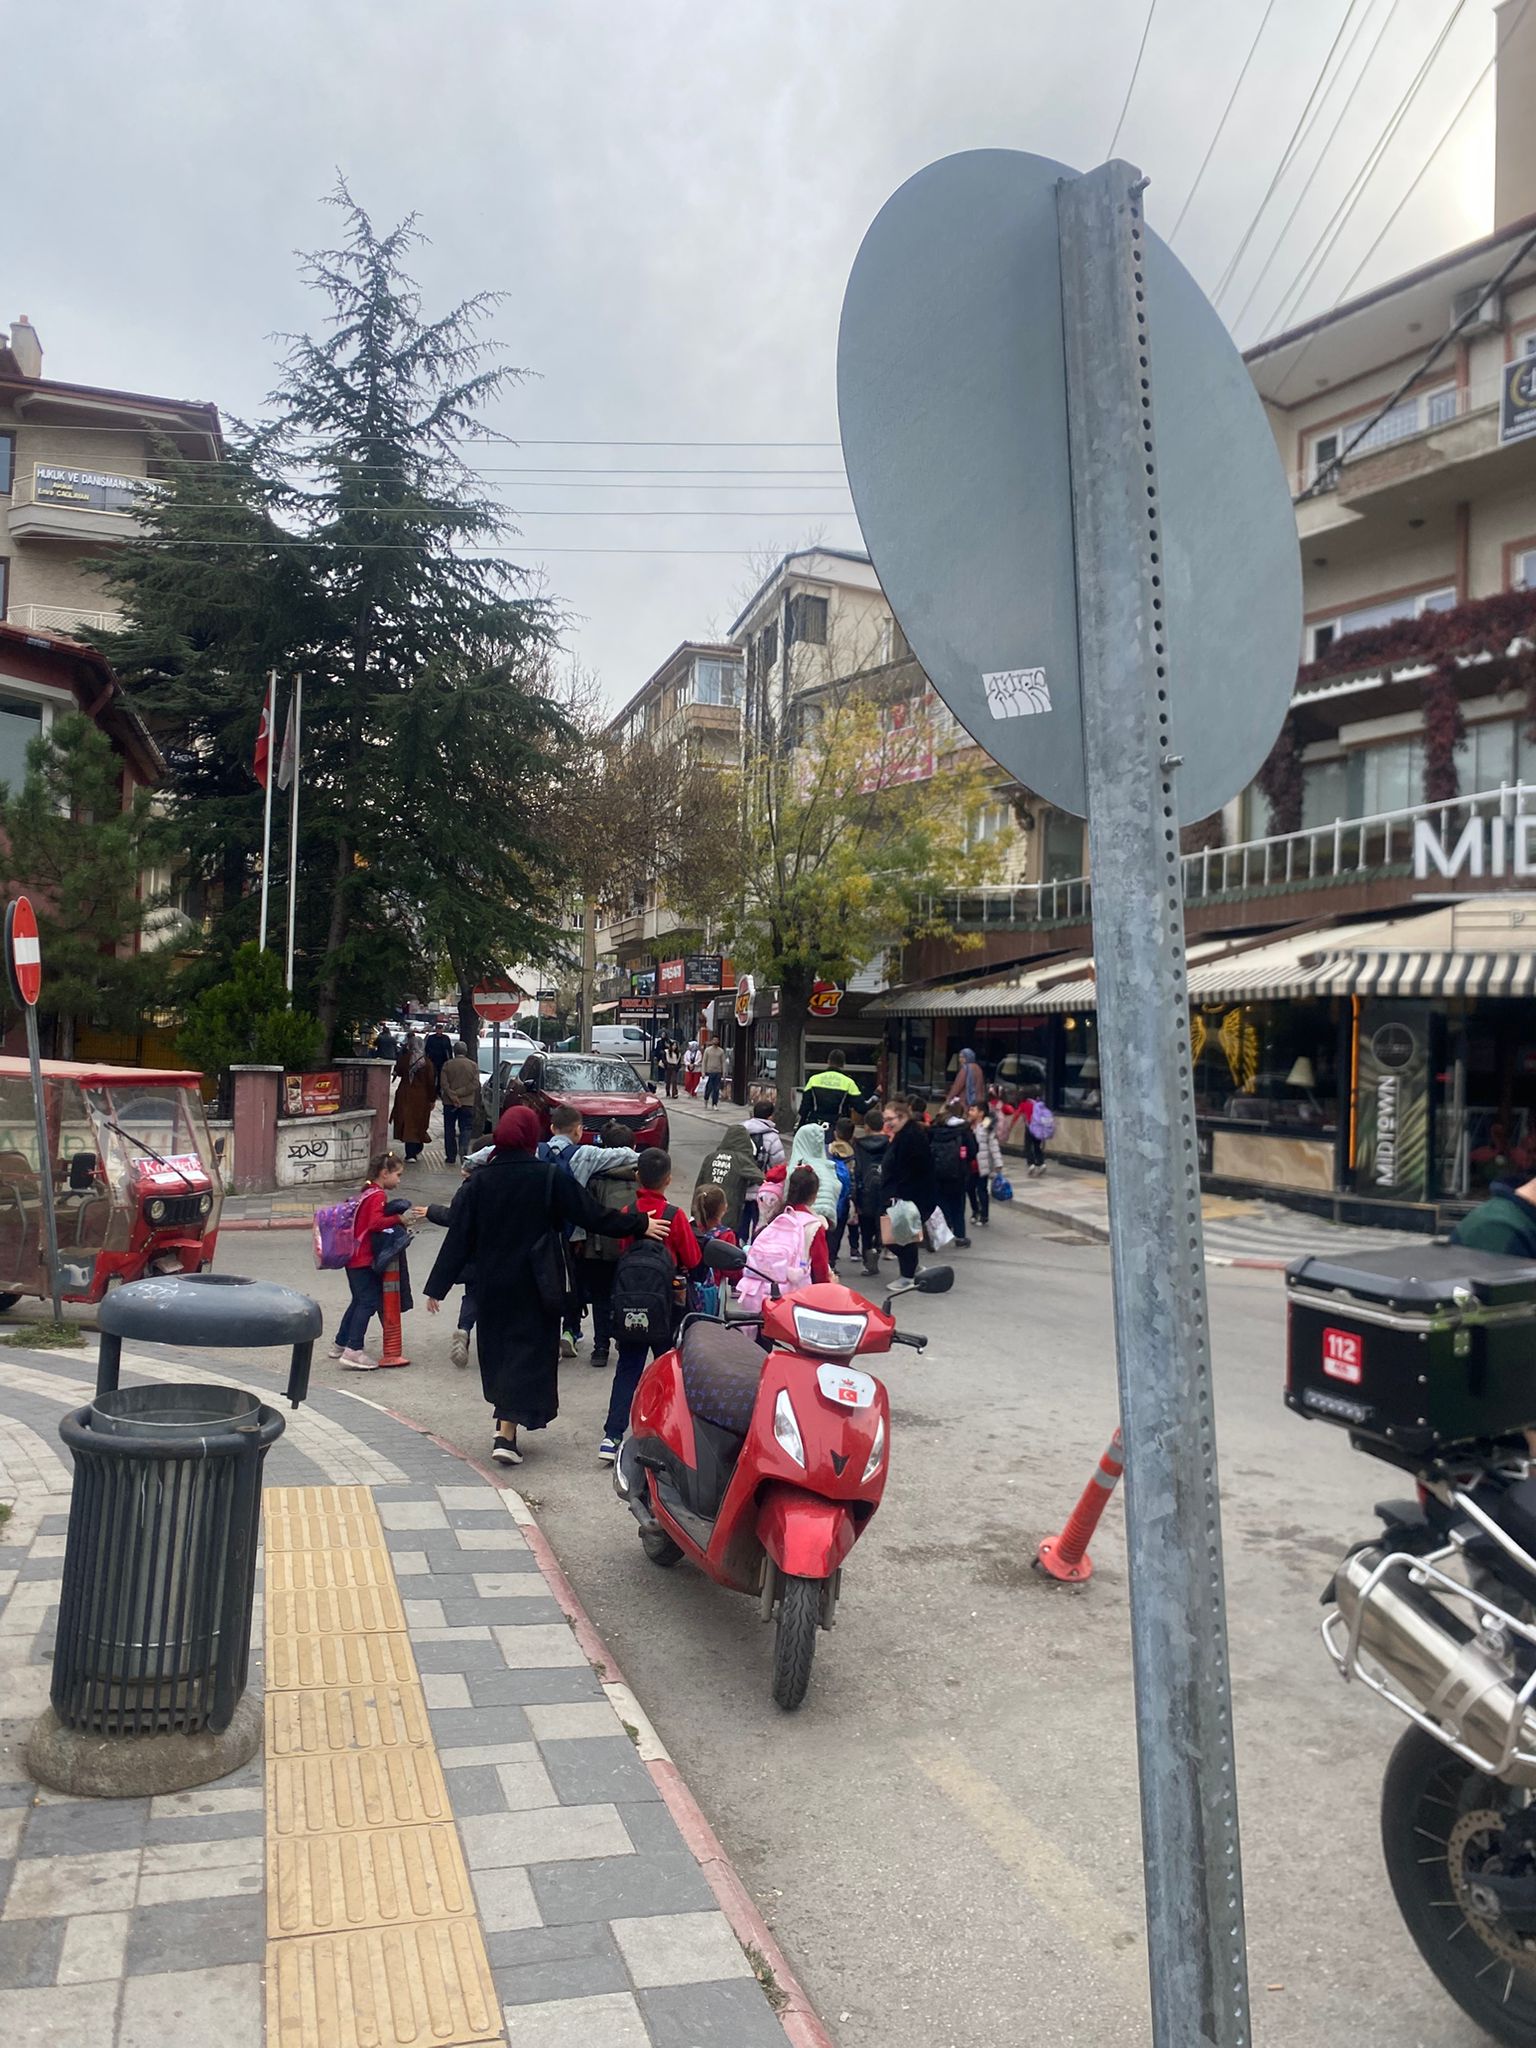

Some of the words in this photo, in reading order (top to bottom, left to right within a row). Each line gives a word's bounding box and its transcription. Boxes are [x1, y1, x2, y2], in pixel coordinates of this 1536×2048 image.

[37, 468, 65, 481] HUKUK
[68, 472, 79, 483] VE
[1376, 1075, 1397, 1187] MIDTOWN
[1328, 1334, 1356, 1362] 112
